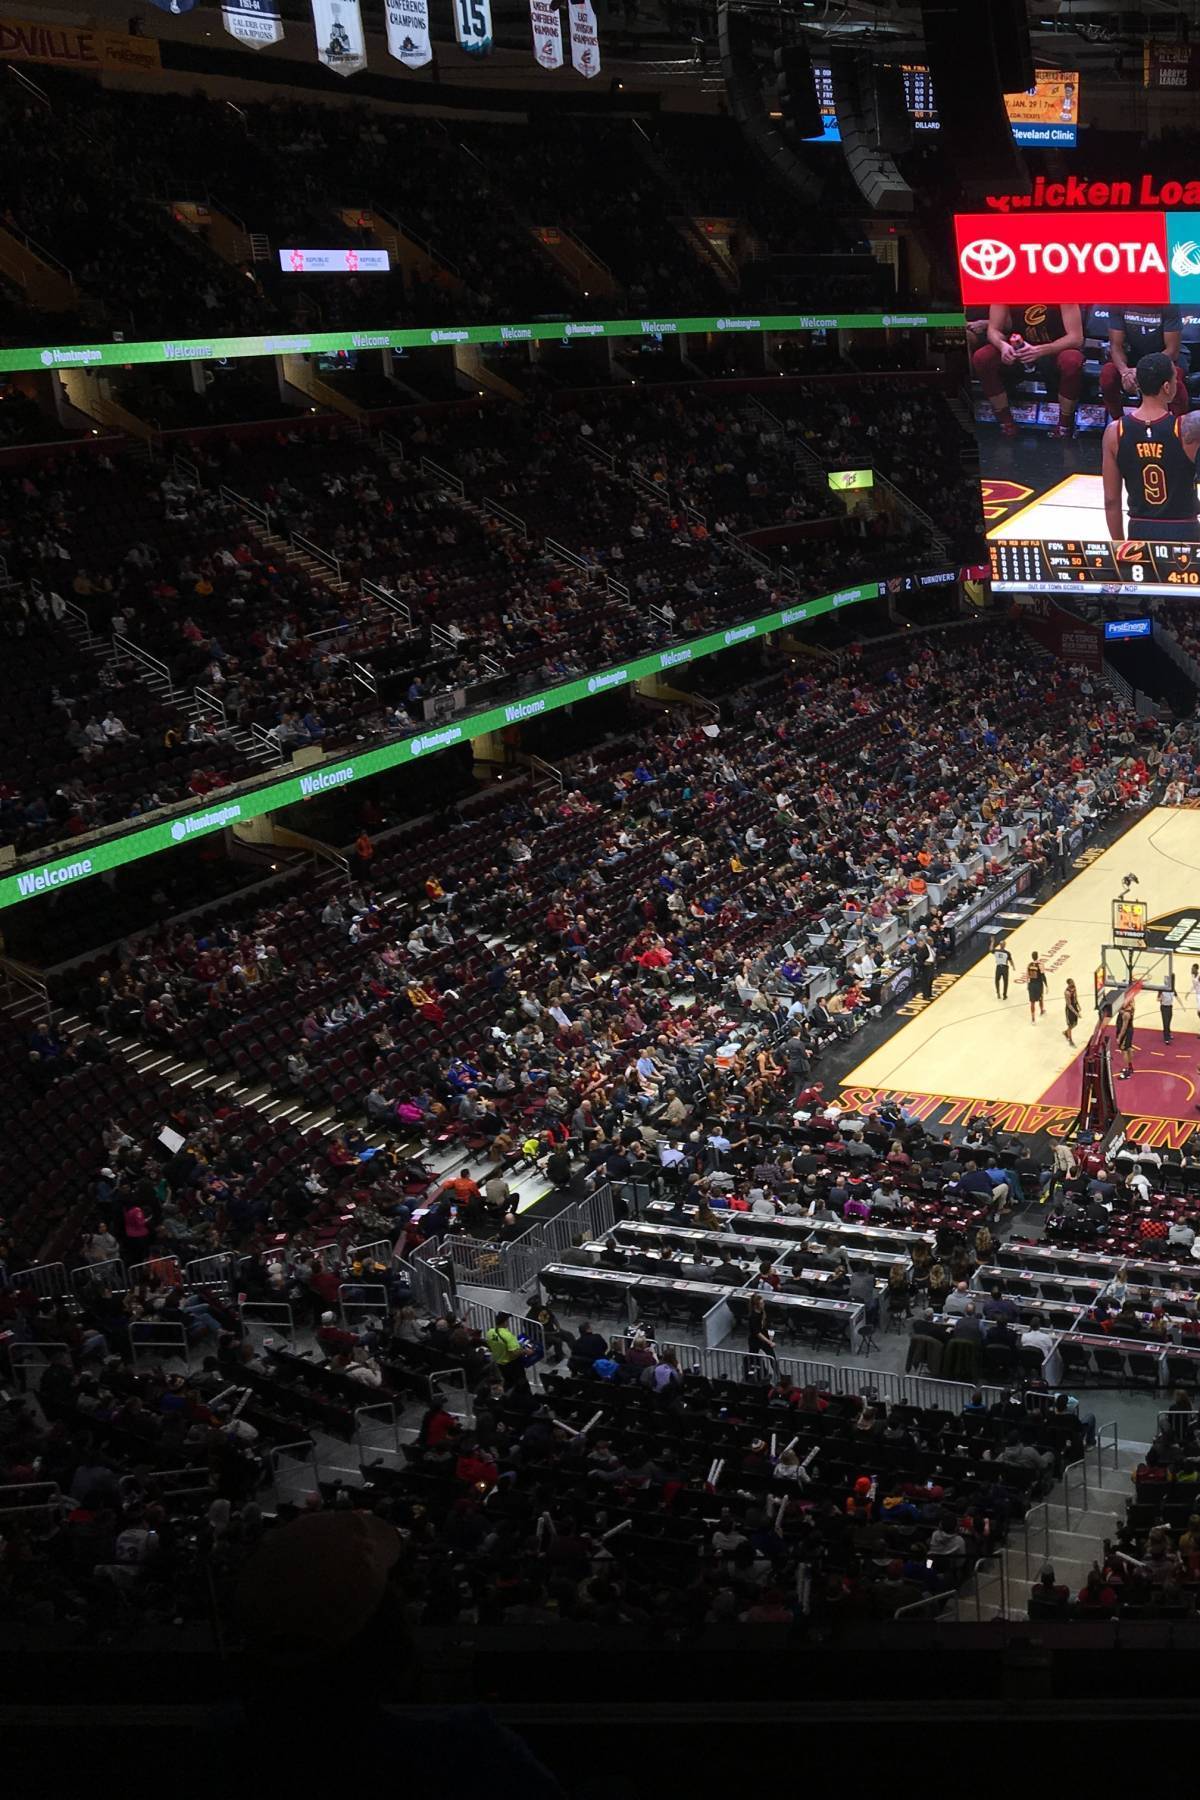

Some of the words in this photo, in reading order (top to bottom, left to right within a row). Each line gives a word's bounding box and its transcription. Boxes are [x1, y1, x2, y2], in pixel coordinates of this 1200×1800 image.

[389, 12, 426, 30] CHAMPIONS
[459, 0, 486, 37] 15
[259, 22, 273, 31] CUP
[234, 27, 273, 40] CHAMPIONS
[1012, 100, 1027, 108] JAN.
[915, 121, 940, 129] DILLARD
[1051, 129, 1075, 140] Clinic
[1020, 242, 1166, 273] TOYOTA
[641, 322, 677, 332] Welcome
[725, 320, 760, 329] Huntington
[800, 318, 838, 327] Welcome
[891, 316, 928, 325] Huntington
[438, 331, 469, 341] Huntington
[501, 327, 532, 339] Welcome
[571, 324, 604, 336] Huntington
[352, 335, 390, 347] Welcome
[53, 350, 102, 363] Huntington
[163, 343, 212, 358] Welcome
[1136, 442, 1164, 459] FRYE
[1142, 463, 1168, 504] 9
[1048, 542, 1064, 551] FG%
[1155, 545, 1168, 558] 1Q
[1050, 557, 1070, 566] 3PT%
[1095, 558, 1102, 567] 2
[920, 572, 955, 585] TURNOVERS
[1058, 572, 1071, 580] TOL
[1131, 564, 1144, 582] 8
[1167, 571, 1199, 584] 4:10
[905, 578, 911, 589] 2
[1108, 622, 1148, 633] FirstEnergy
[660, 648, 692, 667] Welcome
[504, 700, 545, 722] Welcome
[421, 727, 462, 749] Huntington
[300, 767, 354, 795] Welcome
[185, 805, 241, 833] Huntington
[16, 858, 92, 896] Welcome
[830, 1087, 1082, 1137] CAVALIERS
